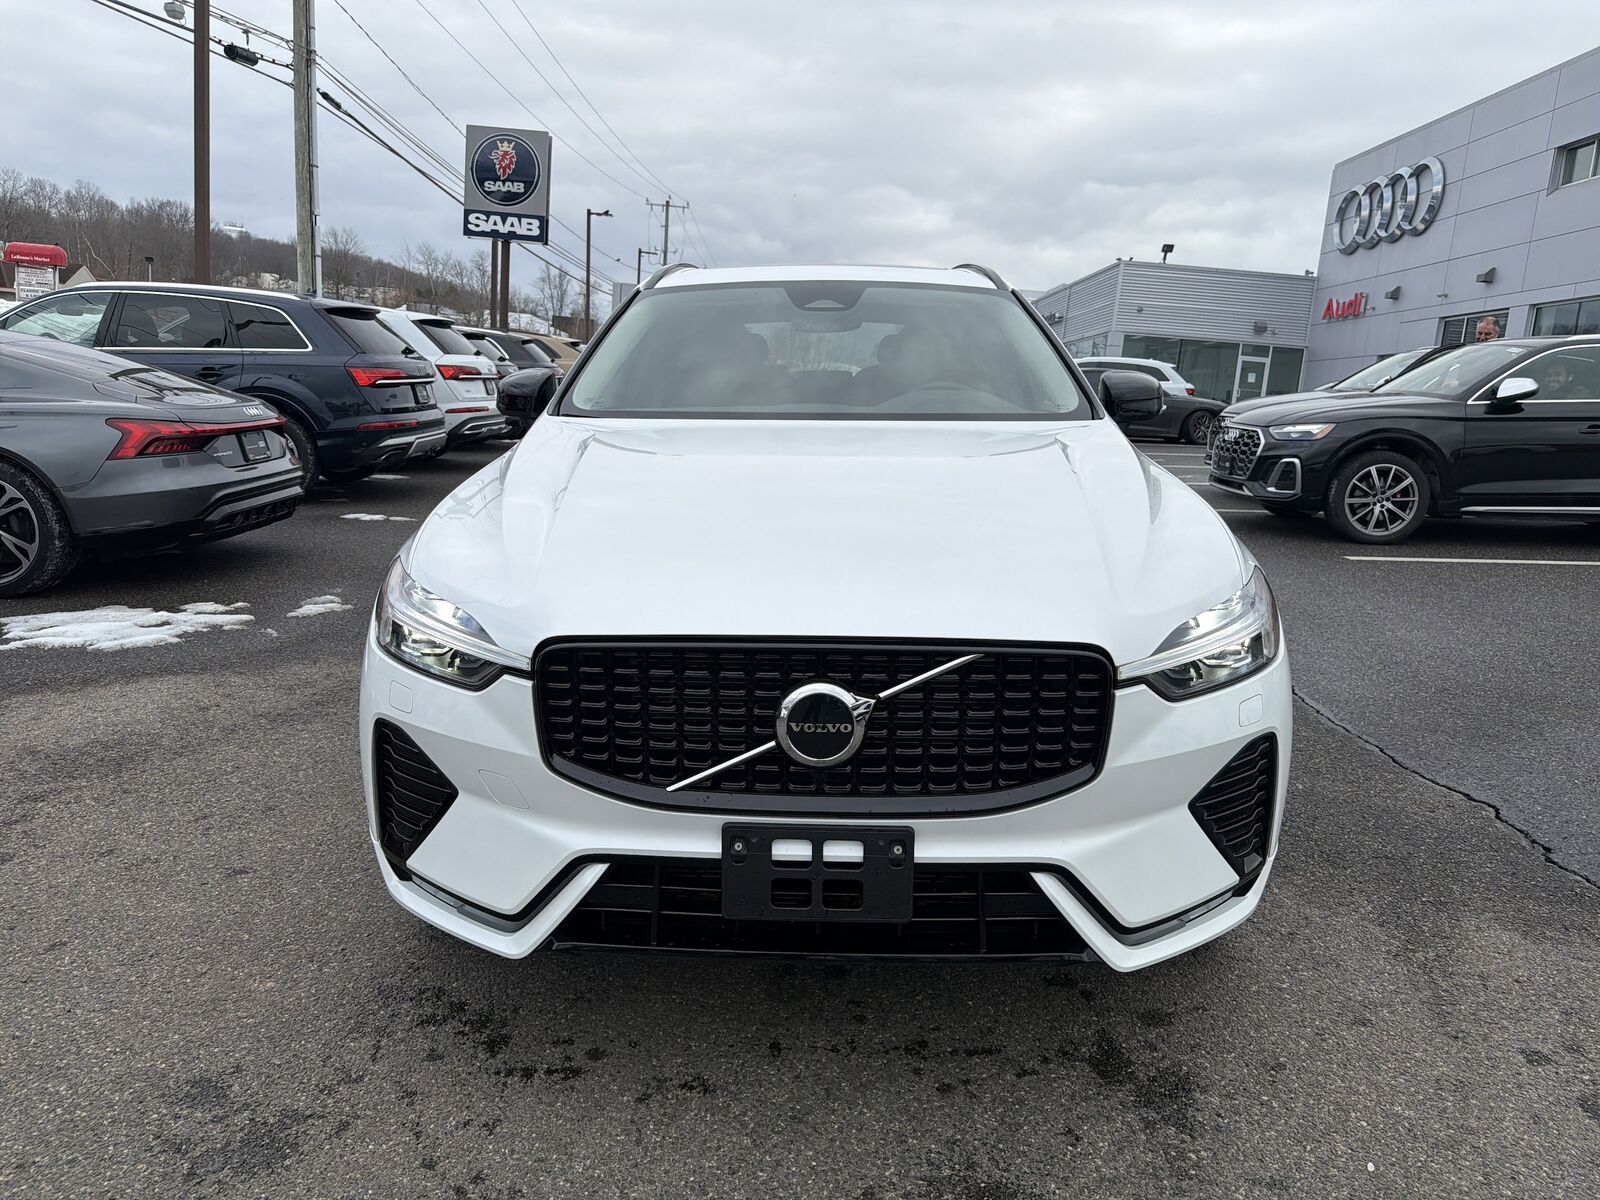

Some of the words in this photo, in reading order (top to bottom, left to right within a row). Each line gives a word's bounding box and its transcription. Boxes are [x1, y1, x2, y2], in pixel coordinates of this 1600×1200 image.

[484, 180, 525, 193] SAAB
[467, 212, 541, 237] SAAB
[1321, 291, 1366, 321] Audi
[789, 722, 852, 733] VOLVO
